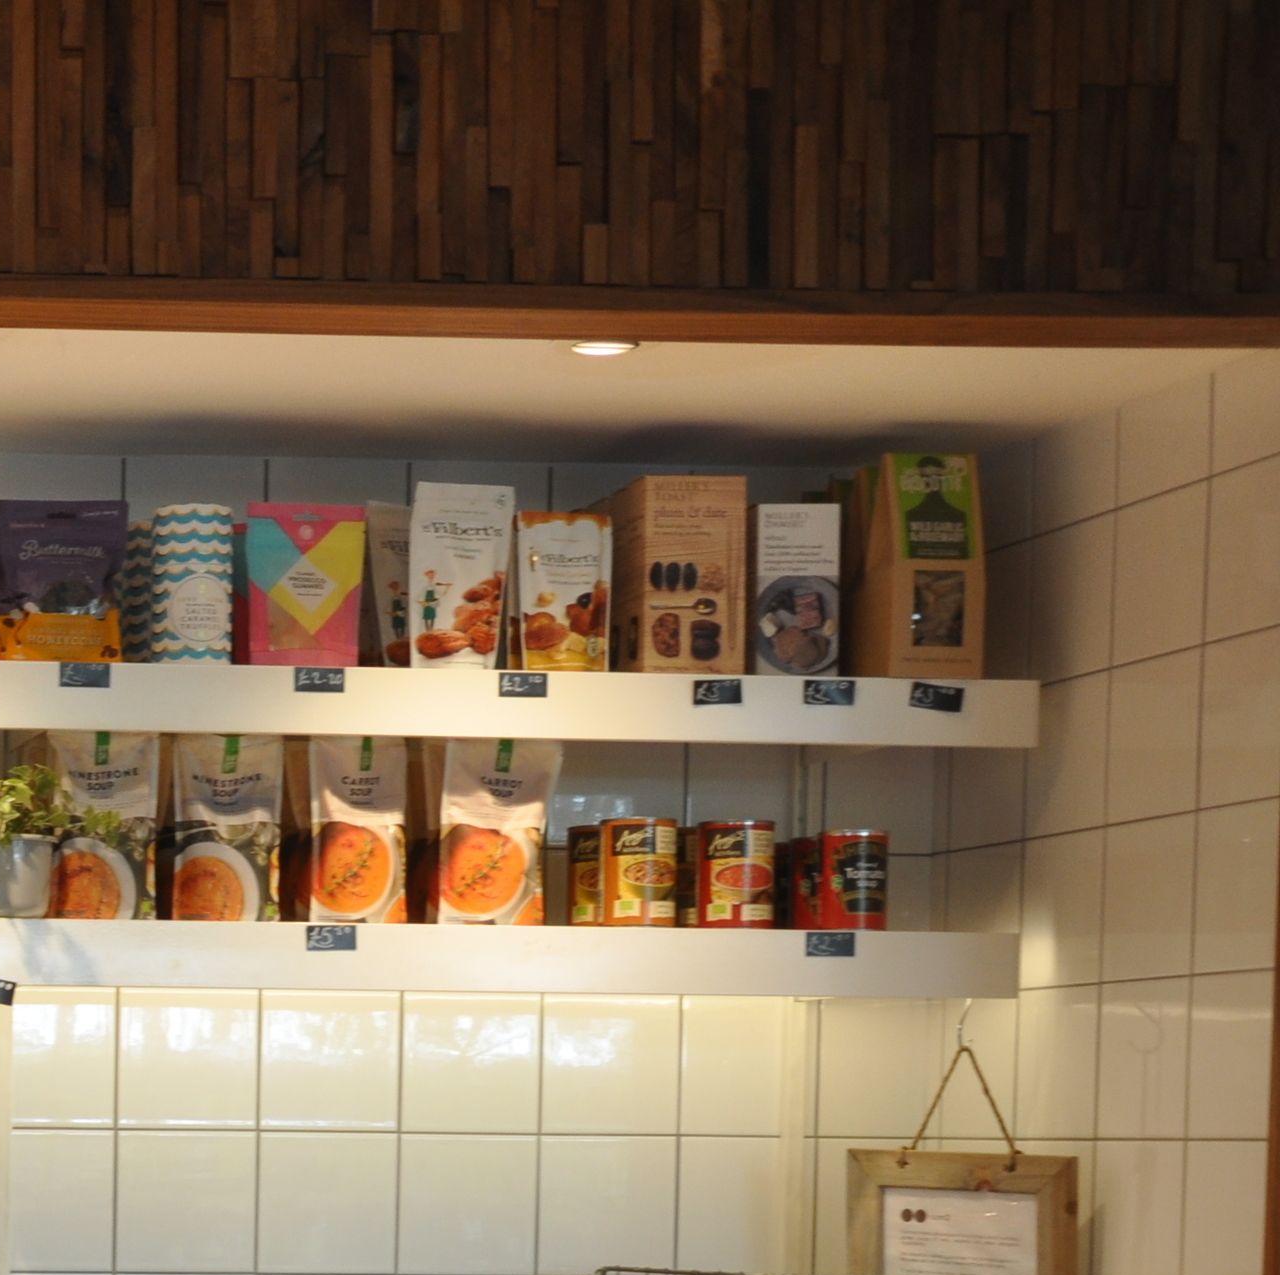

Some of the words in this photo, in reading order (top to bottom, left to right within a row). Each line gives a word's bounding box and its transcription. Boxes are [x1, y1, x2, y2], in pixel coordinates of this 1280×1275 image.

[86, 780, 114, 793] SOUP
[341, 776, 381, 788] CARROT
[211, 785, 240, 798] SOUP
[349, 787, 372, 798] SOUP
